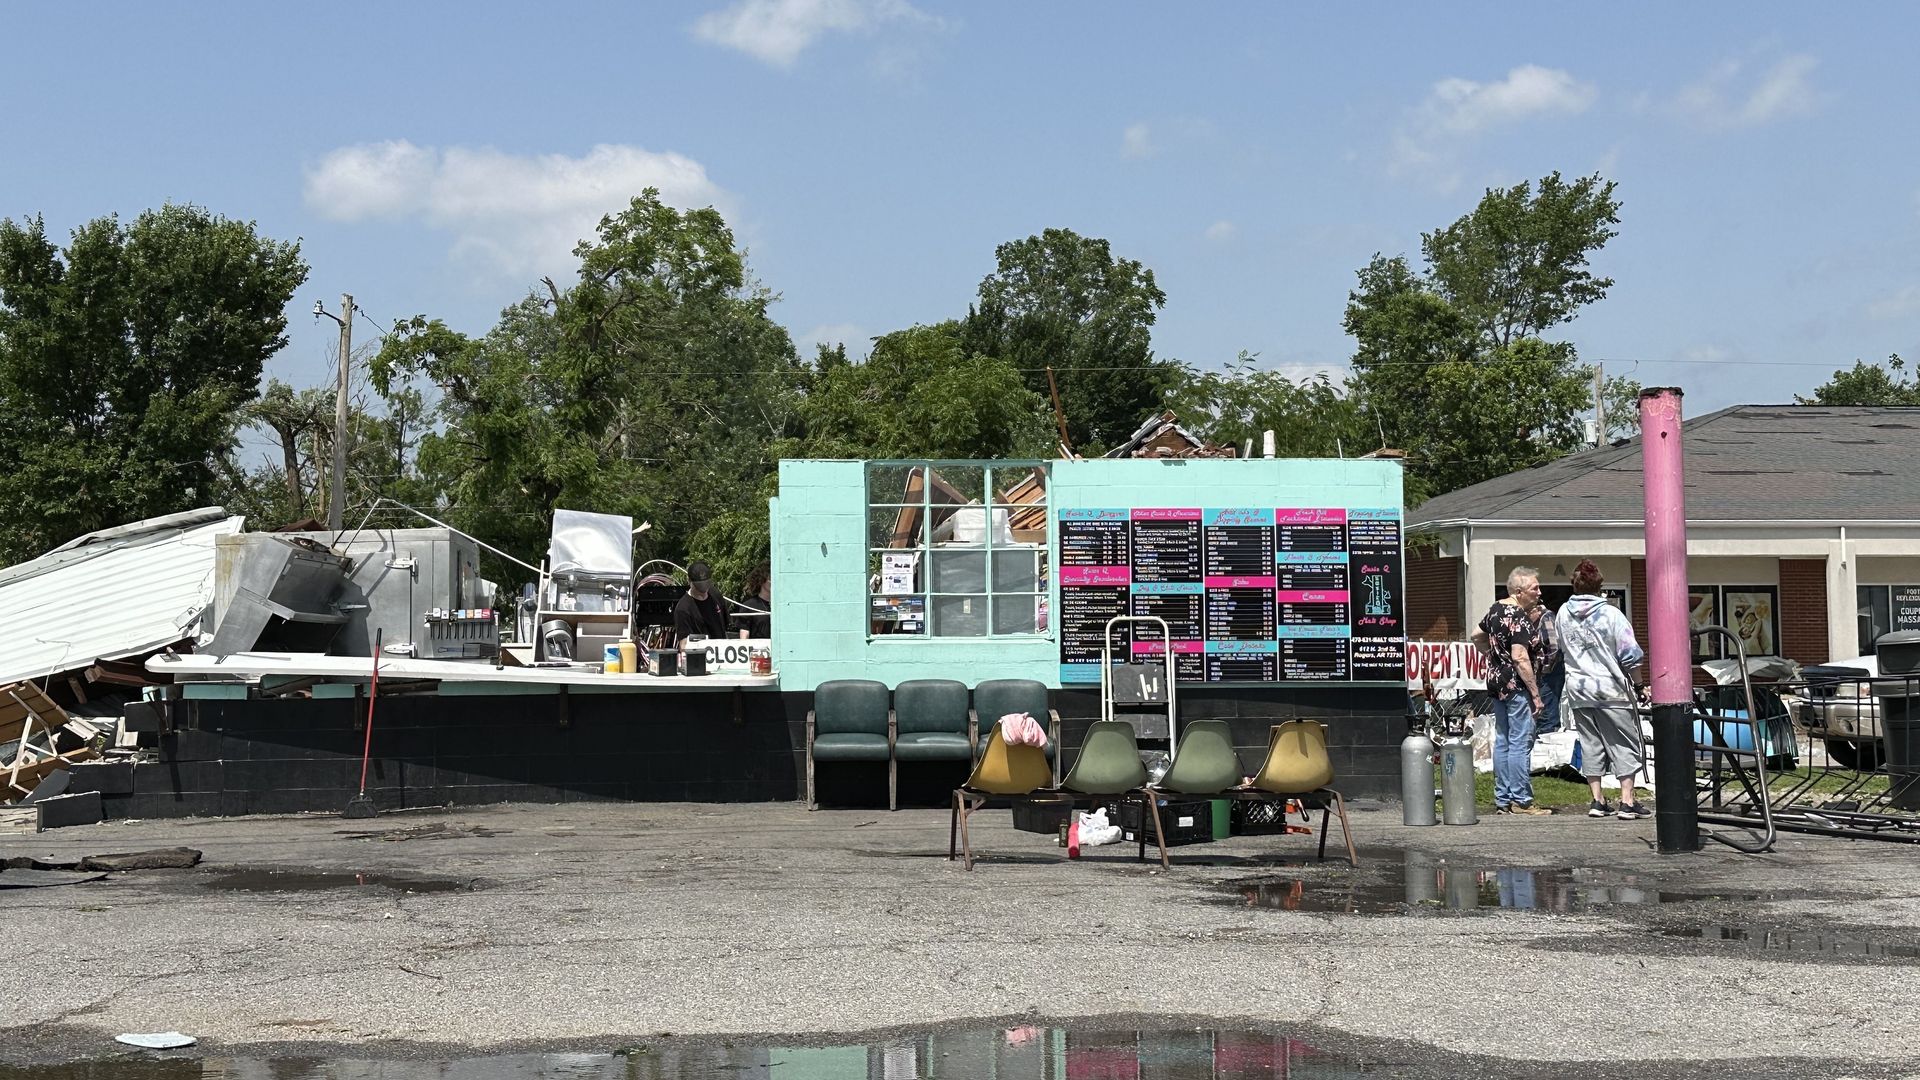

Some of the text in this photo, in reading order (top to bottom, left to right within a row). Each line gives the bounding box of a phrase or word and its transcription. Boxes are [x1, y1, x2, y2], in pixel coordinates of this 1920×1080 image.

[1383, 564, 1391, 573] Q
[1553, 563, 1566, 577] A
[1378, 616, 1397, 627] Shop
